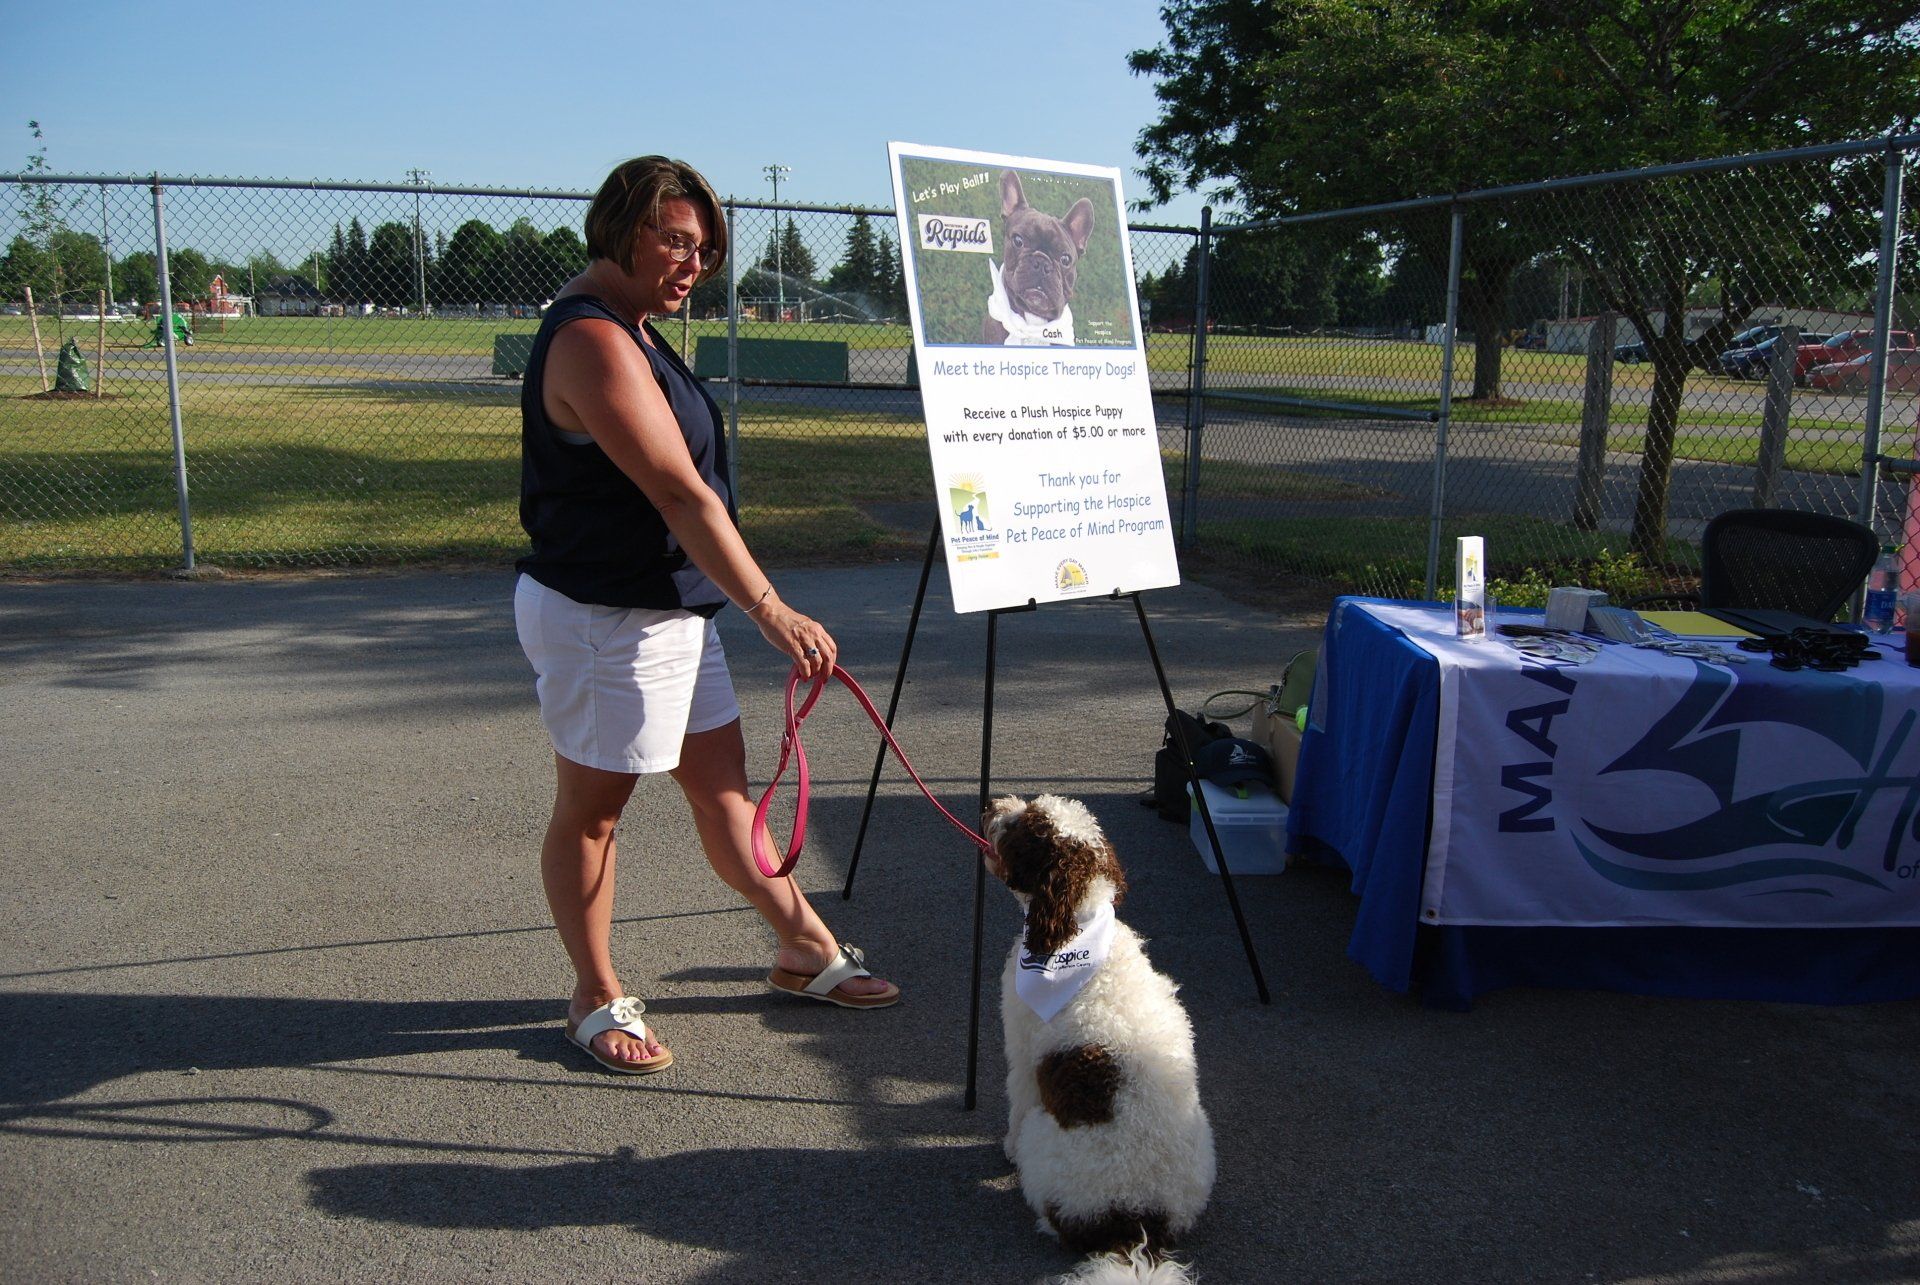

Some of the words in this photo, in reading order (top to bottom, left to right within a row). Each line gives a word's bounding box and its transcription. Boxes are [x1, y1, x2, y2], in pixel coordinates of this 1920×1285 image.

[912, 187, 938, 203] Let's
[940, 182, 960, 196] Play
[962, 172, 990, 190] Ball!!
[925, 218, 988, 250] Rapids
[1042, 328, 1063, 338] Cash
[933, 361, 971, 376] Meet
[973, 361, 996, 376] the
[1000, 361, 1049, 379] Hospice
[1053, 361, 1102, 379] Therapy
[1105, 361, 1136, 379] Dogs!
[963, 407, 1006, 420] Receive
[1010, 410, 1018, 419] a
[1021, 406, 1049, 419] Plush
[1052, 406, 1092, 421] Hospice
[1095, 405, 1123, 419] Puppy
[943, 430, 969, 444] with
[972, 431, 1004, 444] every
[1008, 427, 1053, 441] donation
[1057, 426, 1068, 439] of
[1072, 426, 1104, 440] $5.00
[1108, 427, 1119, 437] or
[1122, 427, 1146, 437] more
[1039, 473, 1076, 487] Thank
[1079, 474, 1099, 489] you
[1102, 470, 1121, 485] for
[1013, 499, 1080, 519] Supporting
[1084, 496, 1104, 512] the
[1107, 494, 1151, 512] Hospice
[986, 533, 1000, 541] Mind
[1006, 528, 1028, 543] Pet
[1031, 527, 1066, 541] Peace
[1069, 524, 1083, 538] of
[1087, 521, 1115, 537] Mind
[1118, 519, 1165, 538] Program
[1498, 650, 1579, 833] MAK
